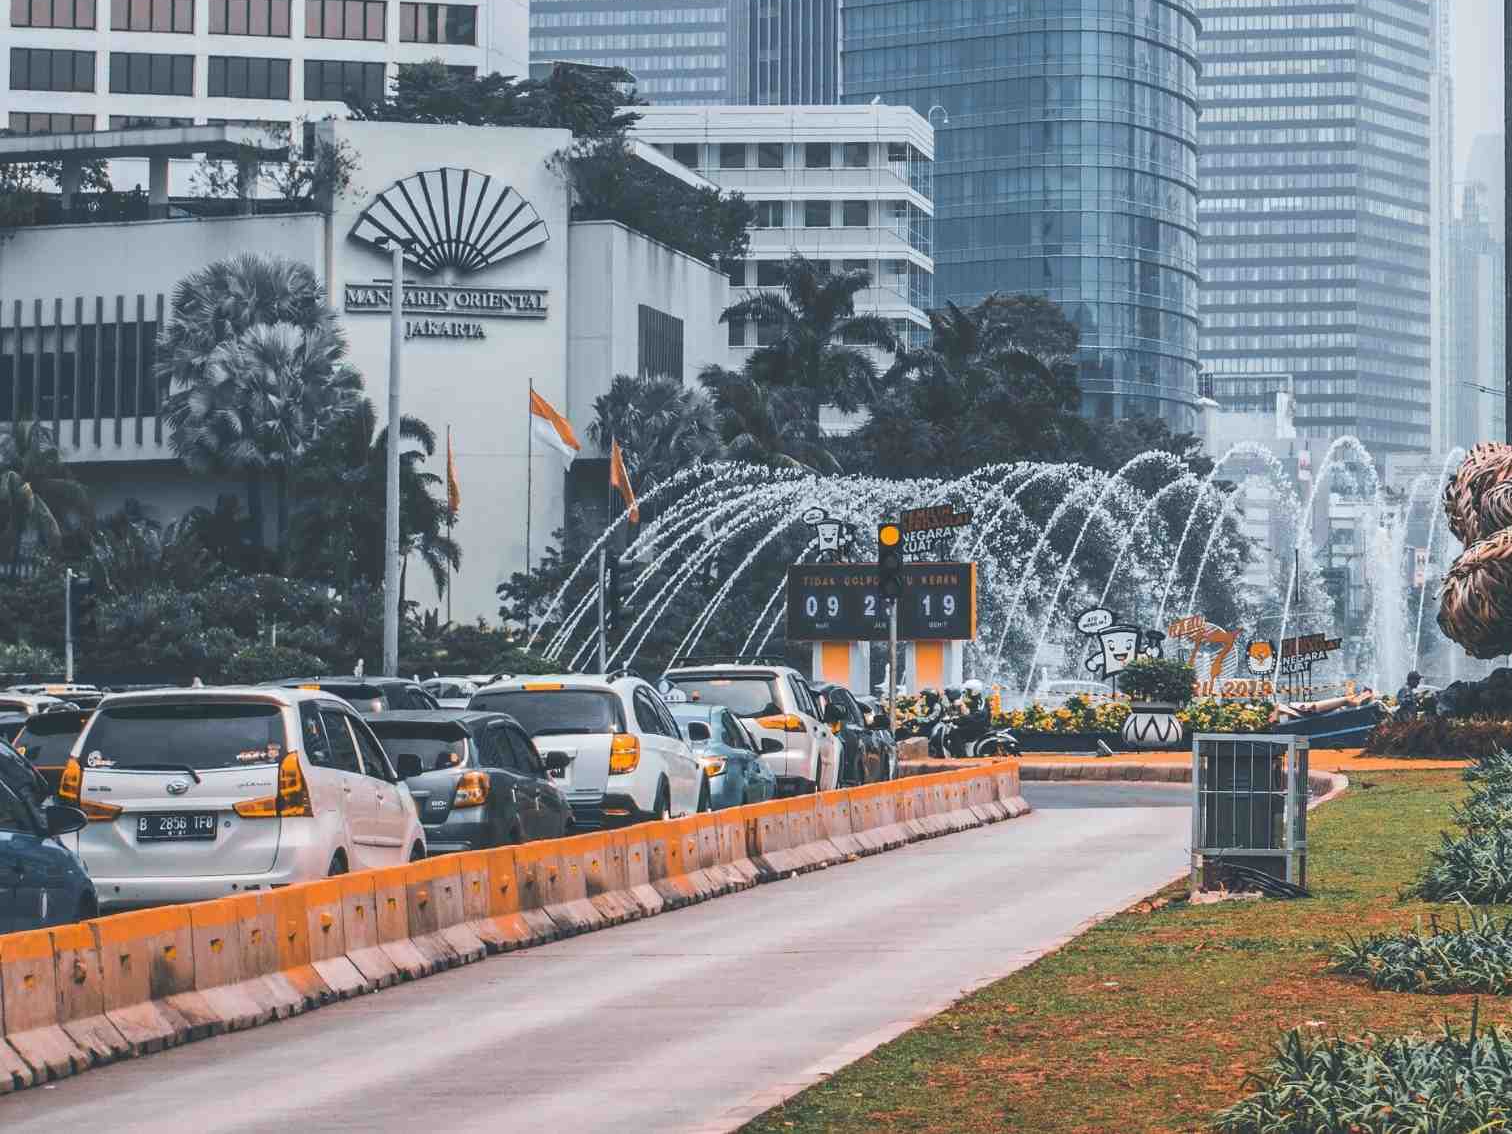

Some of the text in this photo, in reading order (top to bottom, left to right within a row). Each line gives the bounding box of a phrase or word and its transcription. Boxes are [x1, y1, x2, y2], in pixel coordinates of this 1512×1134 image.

[345, 288, 547, 310] MANARIN ORIENTAL
[404, 320, 486, 340] JAKARTA
[902, 527, 952, 543] NEGARA
[1282, 651, 1326, 665] NEGARA
[1283, 661, 1310, 674] KUAT
[139, 818, 148, 831] B
